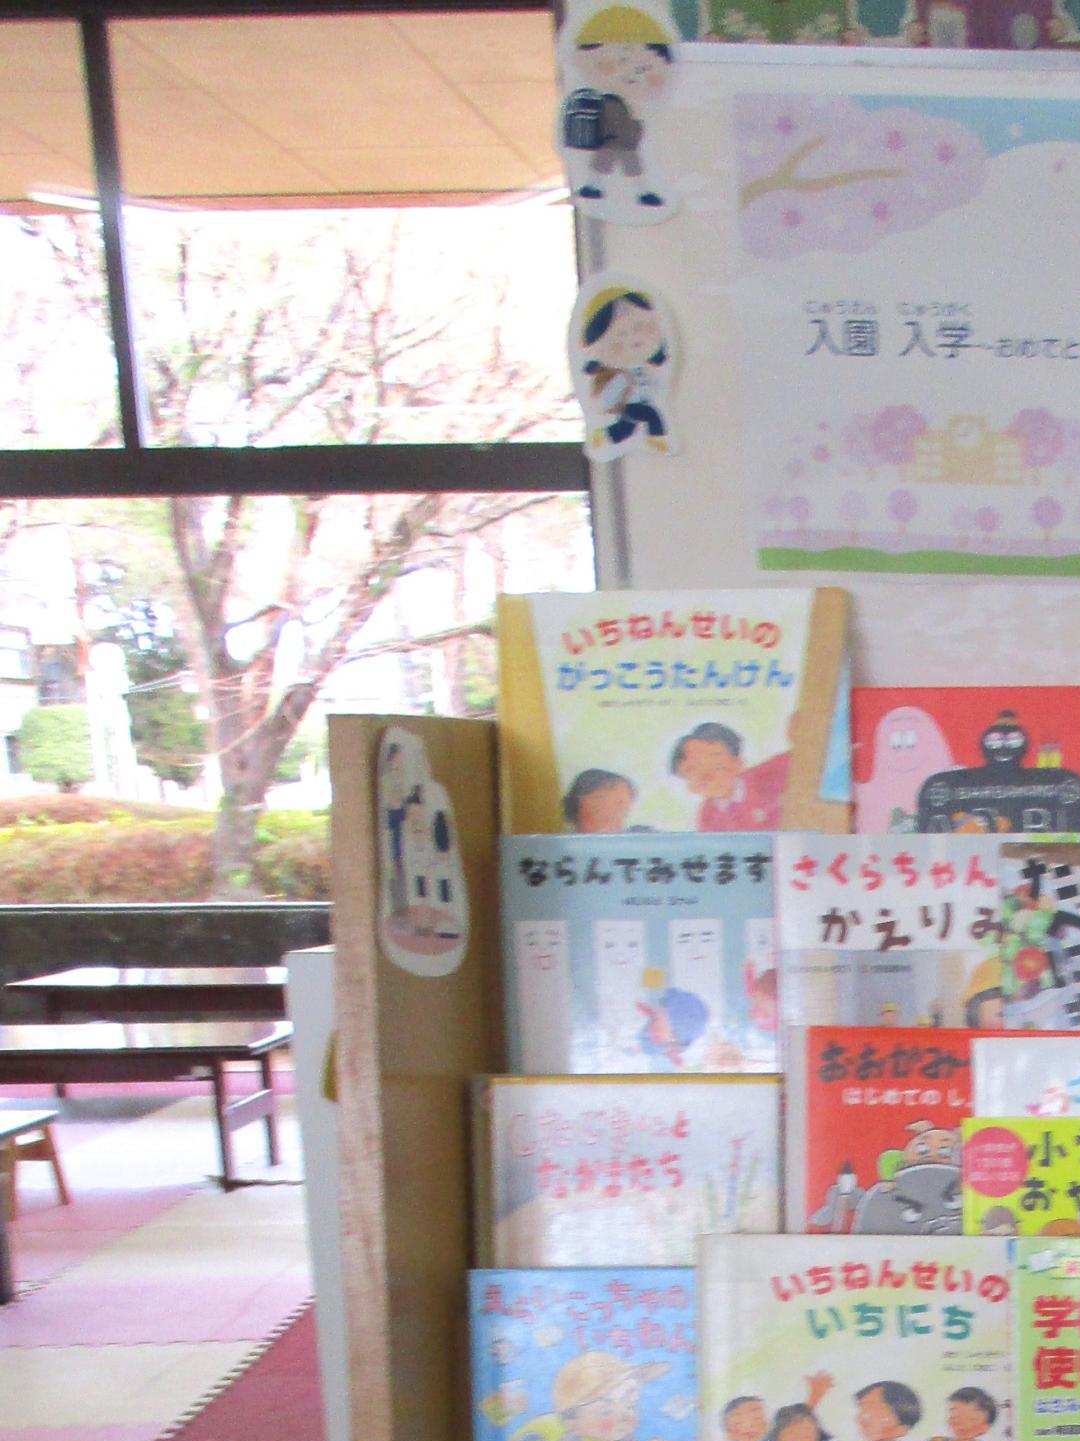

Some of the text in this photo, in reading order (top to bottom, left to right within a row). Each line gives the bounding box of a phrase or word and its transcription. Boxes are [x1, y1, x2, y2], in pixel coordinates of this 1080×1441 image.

[804, 319, 880, 357] 入園
[562, 610, 782, 657] いちねんせいの
[556, 658, 795, 692] がっこうたんけん
[518, 851, 774, 888] ならんでみせます
[790, 852, 998, 891] さくらちゃん
[770, 1259, 1011, 1304] いちねんせいの
[574, 1316, 700, 1357] いちねん
[806, 1303, 976, 1341] いちにち
